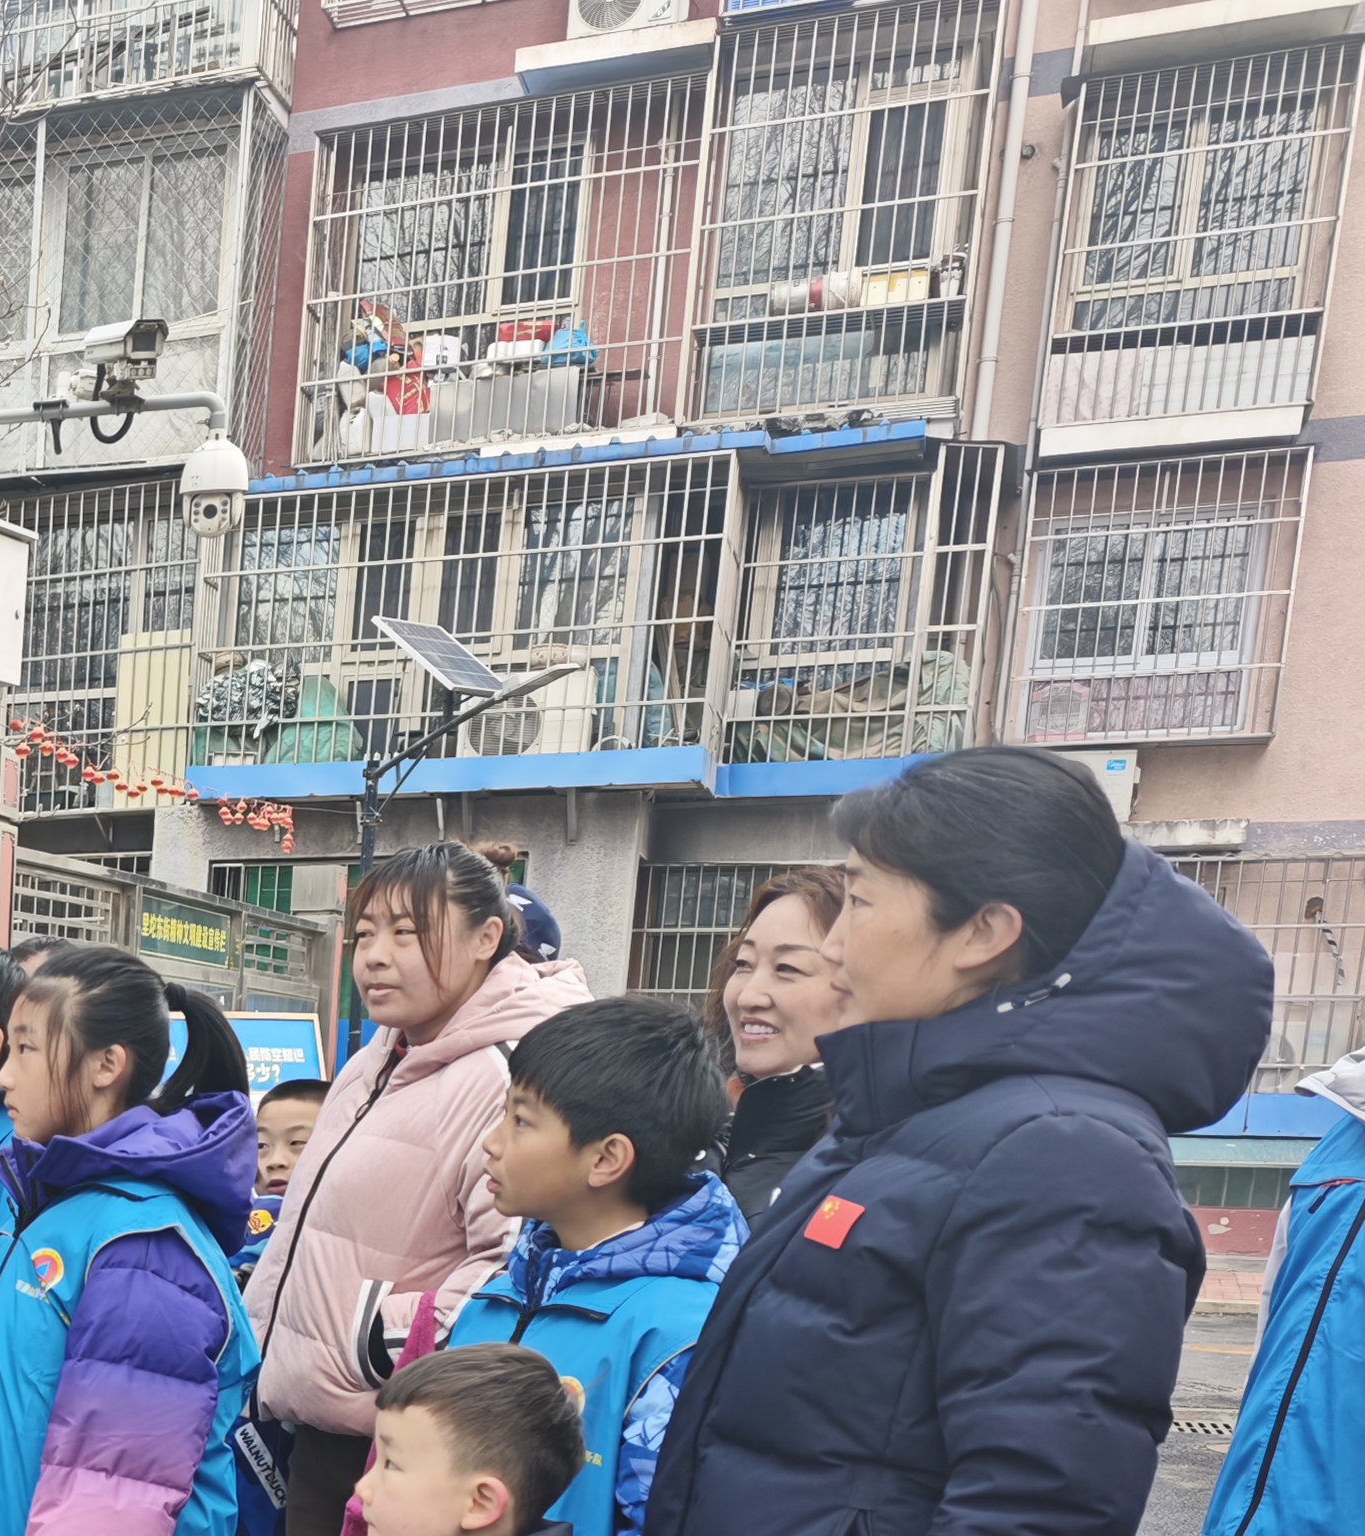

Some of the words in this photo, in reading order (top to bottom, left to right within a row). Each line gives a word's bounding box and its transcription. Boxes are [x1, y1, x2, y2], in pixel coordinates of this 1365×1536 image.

[246, 1046, 306, 1063] 民防空知识
